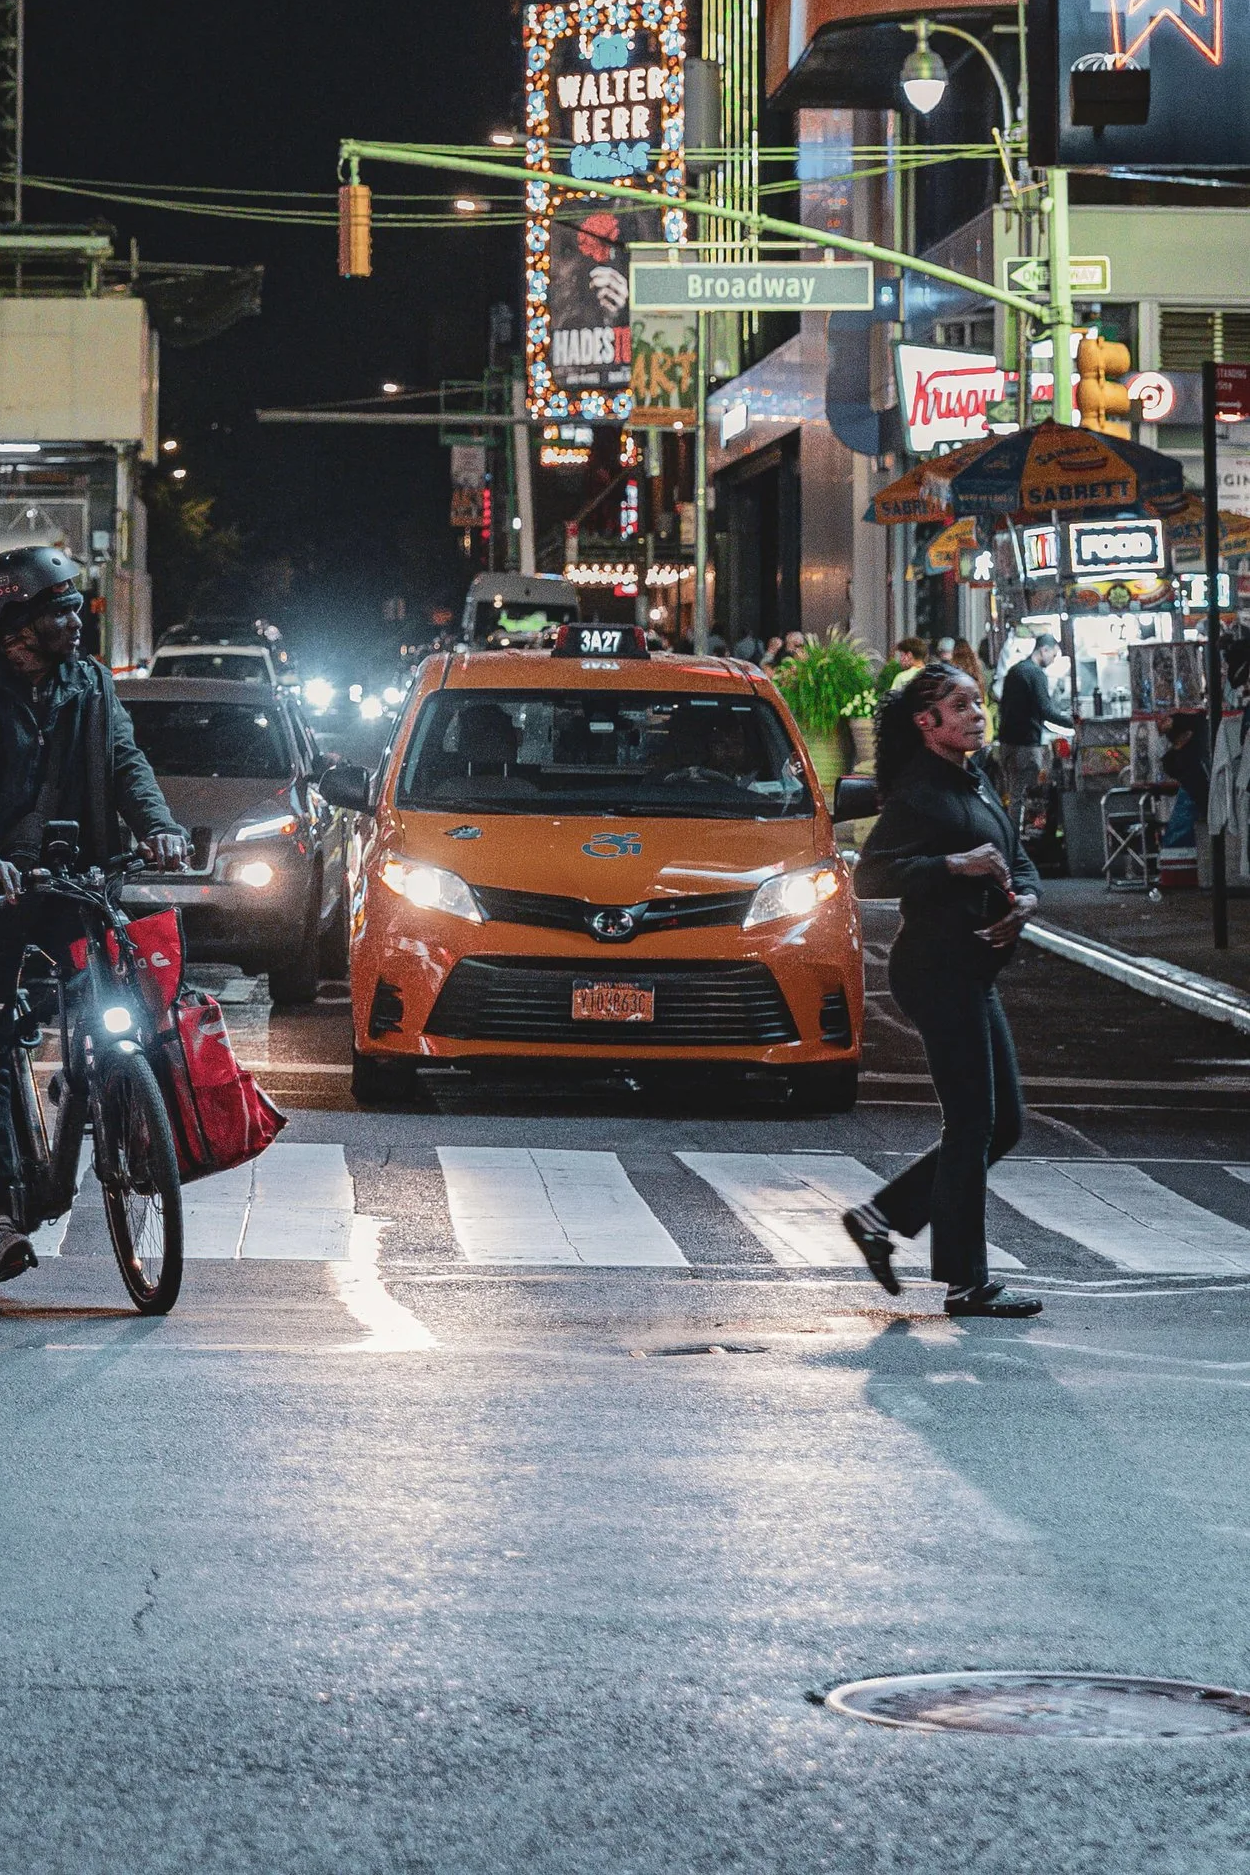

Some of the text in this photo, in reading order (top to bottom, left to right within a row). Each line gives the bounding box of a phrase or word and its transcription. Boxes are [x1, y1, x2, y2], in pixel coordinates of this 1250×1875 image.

[557, 66, 669, 109] WALTER
[573, 105, 650, 144] KERR
[687, 272, 816, 304] Broadway
[630, 351, 698, 399] ART
[1027, 479, 1131, 505] SABRETT
[1080, 532, 1152, 561] FOOD
[580, 629, 622, 653] 3A27
